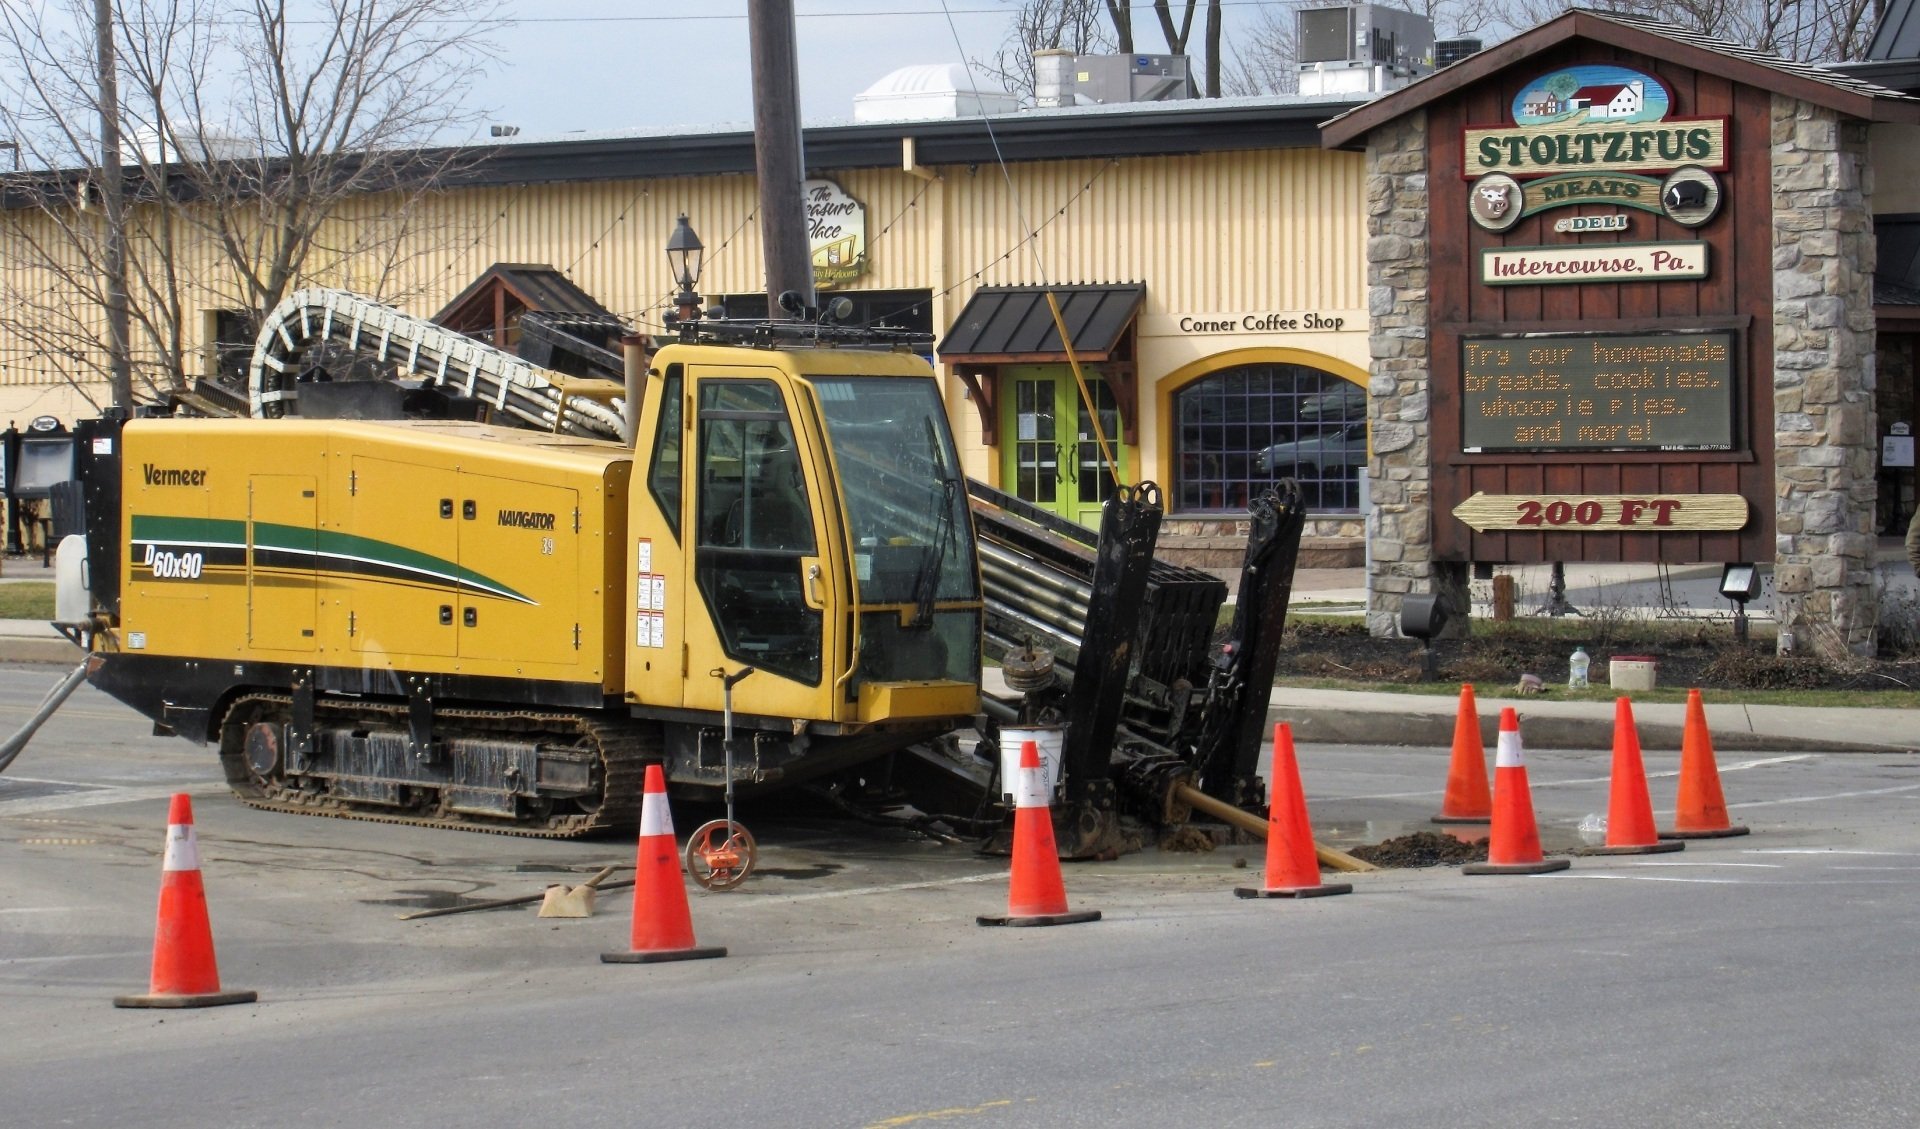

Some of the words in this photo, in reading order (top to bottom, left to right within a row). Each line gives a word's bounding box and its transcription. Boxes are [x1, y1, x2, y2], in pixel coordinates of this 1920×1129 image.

[1478, 128, 1711, 168] STOLTZFUS
[810, 185, 832, 202] The
[1542, 180, 1641, 201] MEATS
[807, 202, 856, 217] easure
[1572, 216, 1628, 231] DELI
[1493, 256, 1644, 277] Intercourse,
[1650, 250, 1694, 271] Pa.
[1179, 317, 1237, 332] Corner
[1242, 314, 1298, 331] Coffee
[1303, 313, 1344, 331] Shop
[1465, 344, 1509, 366] Try
[1529, 348, 1573, 365] our
[1594, 339, 1725, 363] homemade
[1465, 370, 1571, 392] breads,
[1594, 366, 1720, 389] cookies,
[1481, 394, 1593, 416] whoopie
[1514, 420, 1561, 442] and
[1578, 419, 1651, 441] more!
[143, 463, 206, 487] Vermeer
[497, 509, 556, 530] NAVIGATOR
[1516, 500, 1604, 527] 200
[1616, 499, 1682, 527] FT
